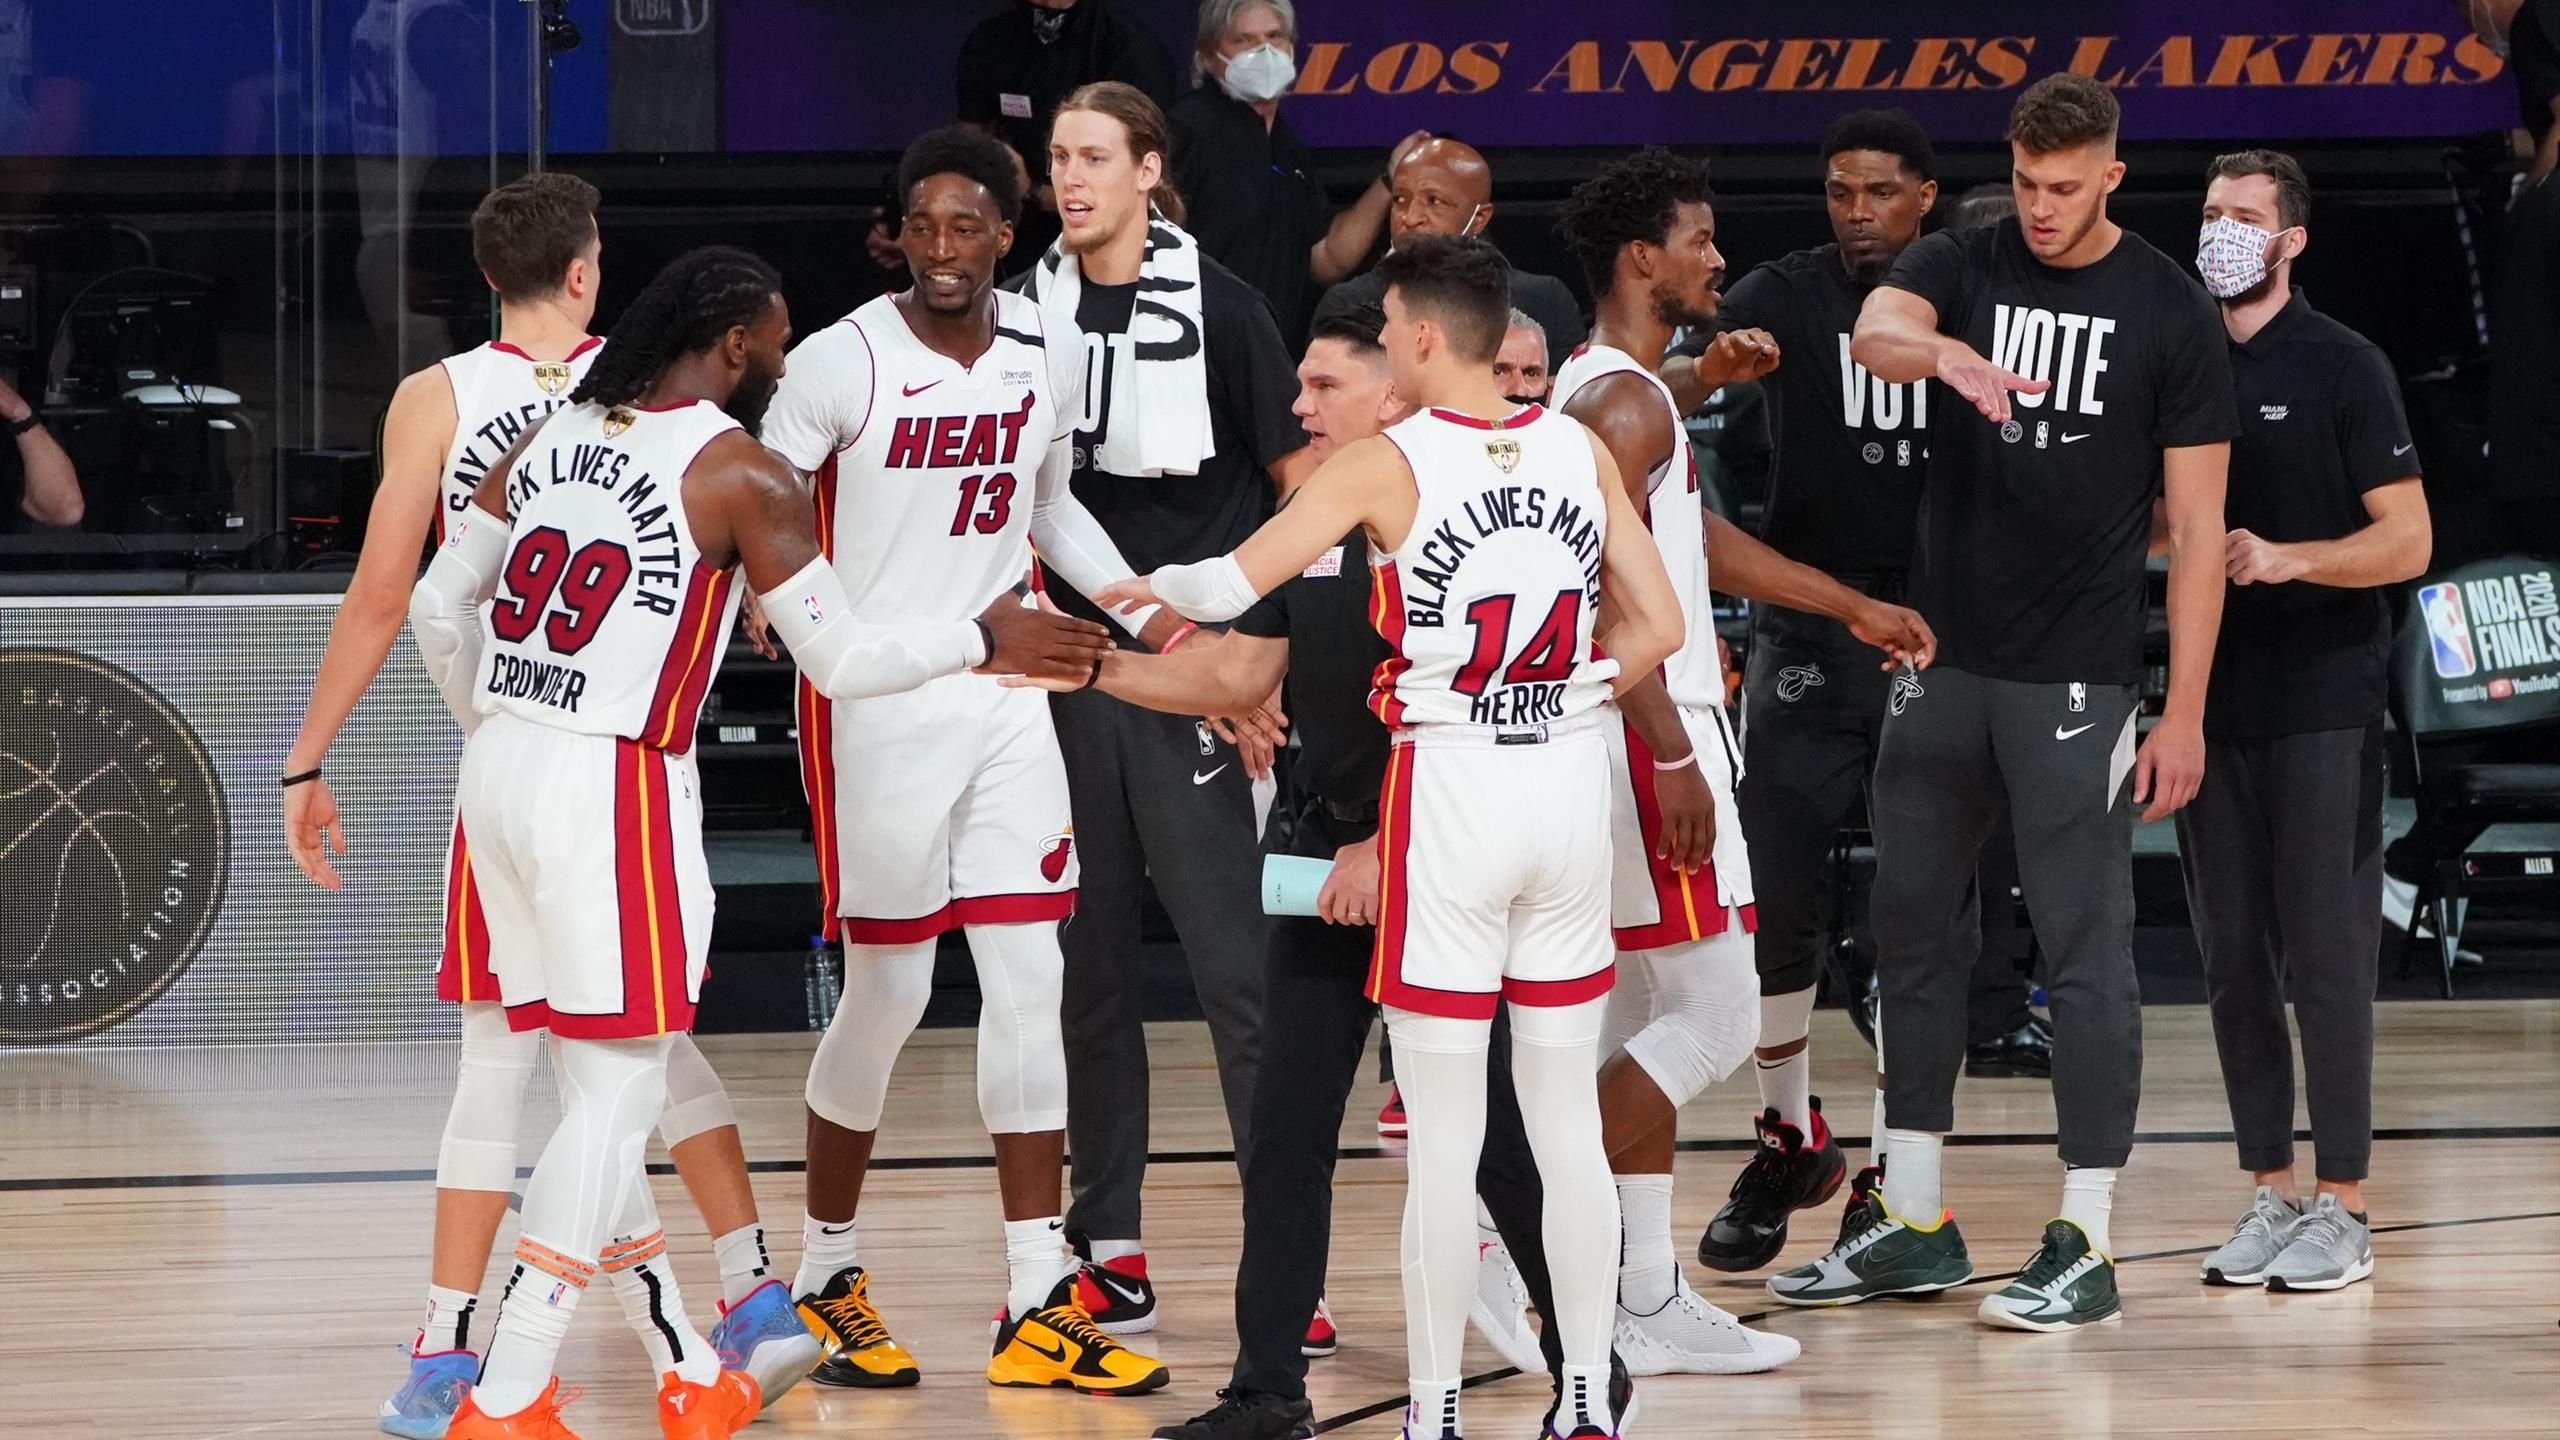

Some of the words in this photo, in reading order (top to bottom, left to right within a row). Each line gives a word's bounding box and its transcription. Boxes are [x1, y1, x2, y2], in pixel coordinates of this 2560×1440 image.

[1286, 41, 1509, 95] LOS
[1528, 36, 2036, 93] ANGELES
[2067, 32, 2504, 88] LAKERS
[1992, 303, 2117, 415] VOTE
[884, 389, 1036, 469] HEAT
[2260, 405, 2287, 413] MIAMI
[551, 444, 630, 490] LIVES
[618, 472, 681, 616] MATTER
[949, 472, 1018, 537] 13
[1313, 557, 1337, 566] ACIAL
[1407, 518, 1476, 628] BLACK
[1463, 486, 1546, 539] LIVES
[490, 525, 633, 656] 99
[2465, 576, 2527, 626] NBA
[2520, 571, 2560, 618] 2020
[1449, 589, 1584, 698] 14
[2475, 615, 2560, 672] FINALS
[488, 652, 587, 713] CROWDER
[1469, 682, 1569, 725] HERRO
[719, 726, 757, 742] GILLIAM
[2525, 858, 2554, 875] ALLEN
